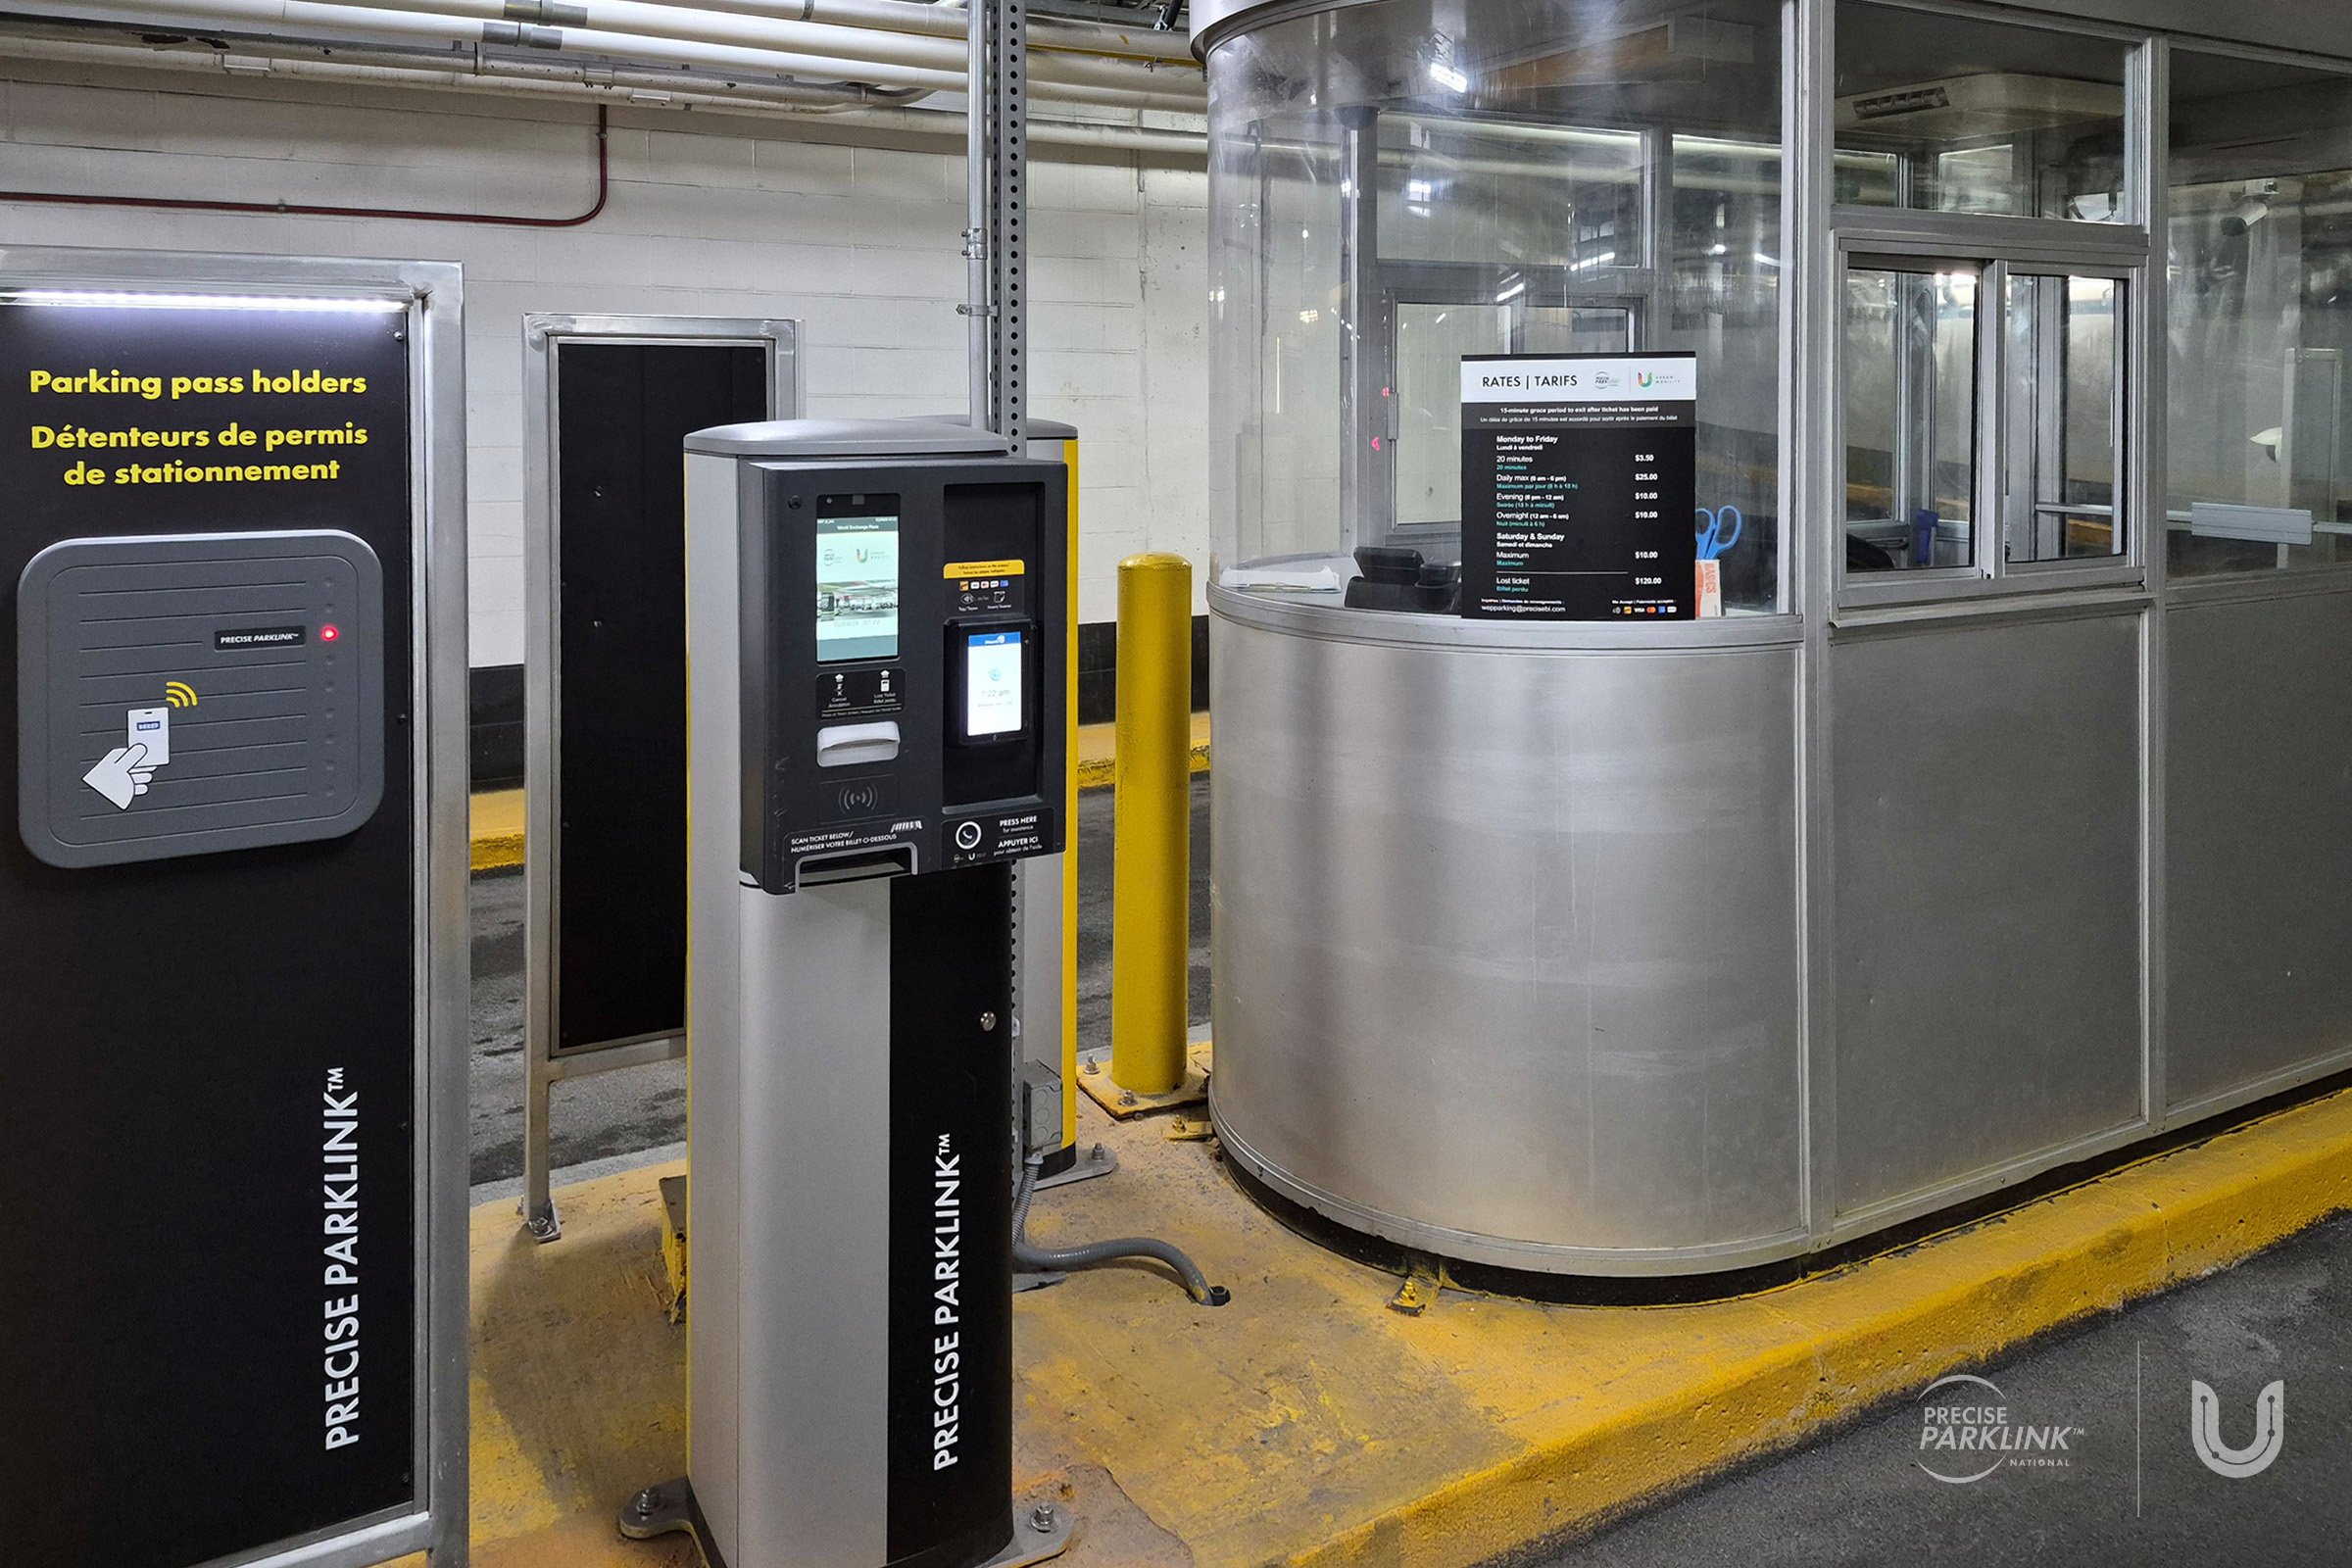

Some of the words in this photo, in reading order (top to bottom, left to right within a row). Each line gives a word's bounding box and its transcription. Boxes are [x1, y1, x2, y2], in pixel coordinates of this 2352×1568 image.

[29, 368, 162, 400] Parking
[171, 375, 244, 400] pass
[252, 368, 367, 394] holders
[1482, 376, 1521, 388] RATES
[1535, 374, 1578, 386] TARIFS
[31, 424, 210, 449] Détenteurs
[218, 422, 258, 447] de
[266, 421, 368, 452] permis
[1496, 435, 1525, 444] Monday
[1535, 435, 1558, 444] Friday
[1635, 454, 1654, 463] $3.50
[63, 461, 106, 485] de
[115, 459, 340, 483] stationnement
[1496, 474, 1513, 483] Daily
[1496, 512, 1529, 520] Overnight
[1635, 511, 1658, 519] $10.00
[1496, 532, 1529, 541] Saturday
[1537, 533, 1565, 542] Sunday
[220, 635, 253, 644] PRECISE
[1000, 817, 1019, 827] PRESS
[792, 837, 808, 846] SCAN
[829, 831, 854, 840] BELOW/
[998, 837, 1028, 849] APPUYER
[791, 843, 824, 854] NUMÉRISER
[324, 1294, 359, 1450] PRECISE
[933, 1332, 959, 1471] PRECISE
